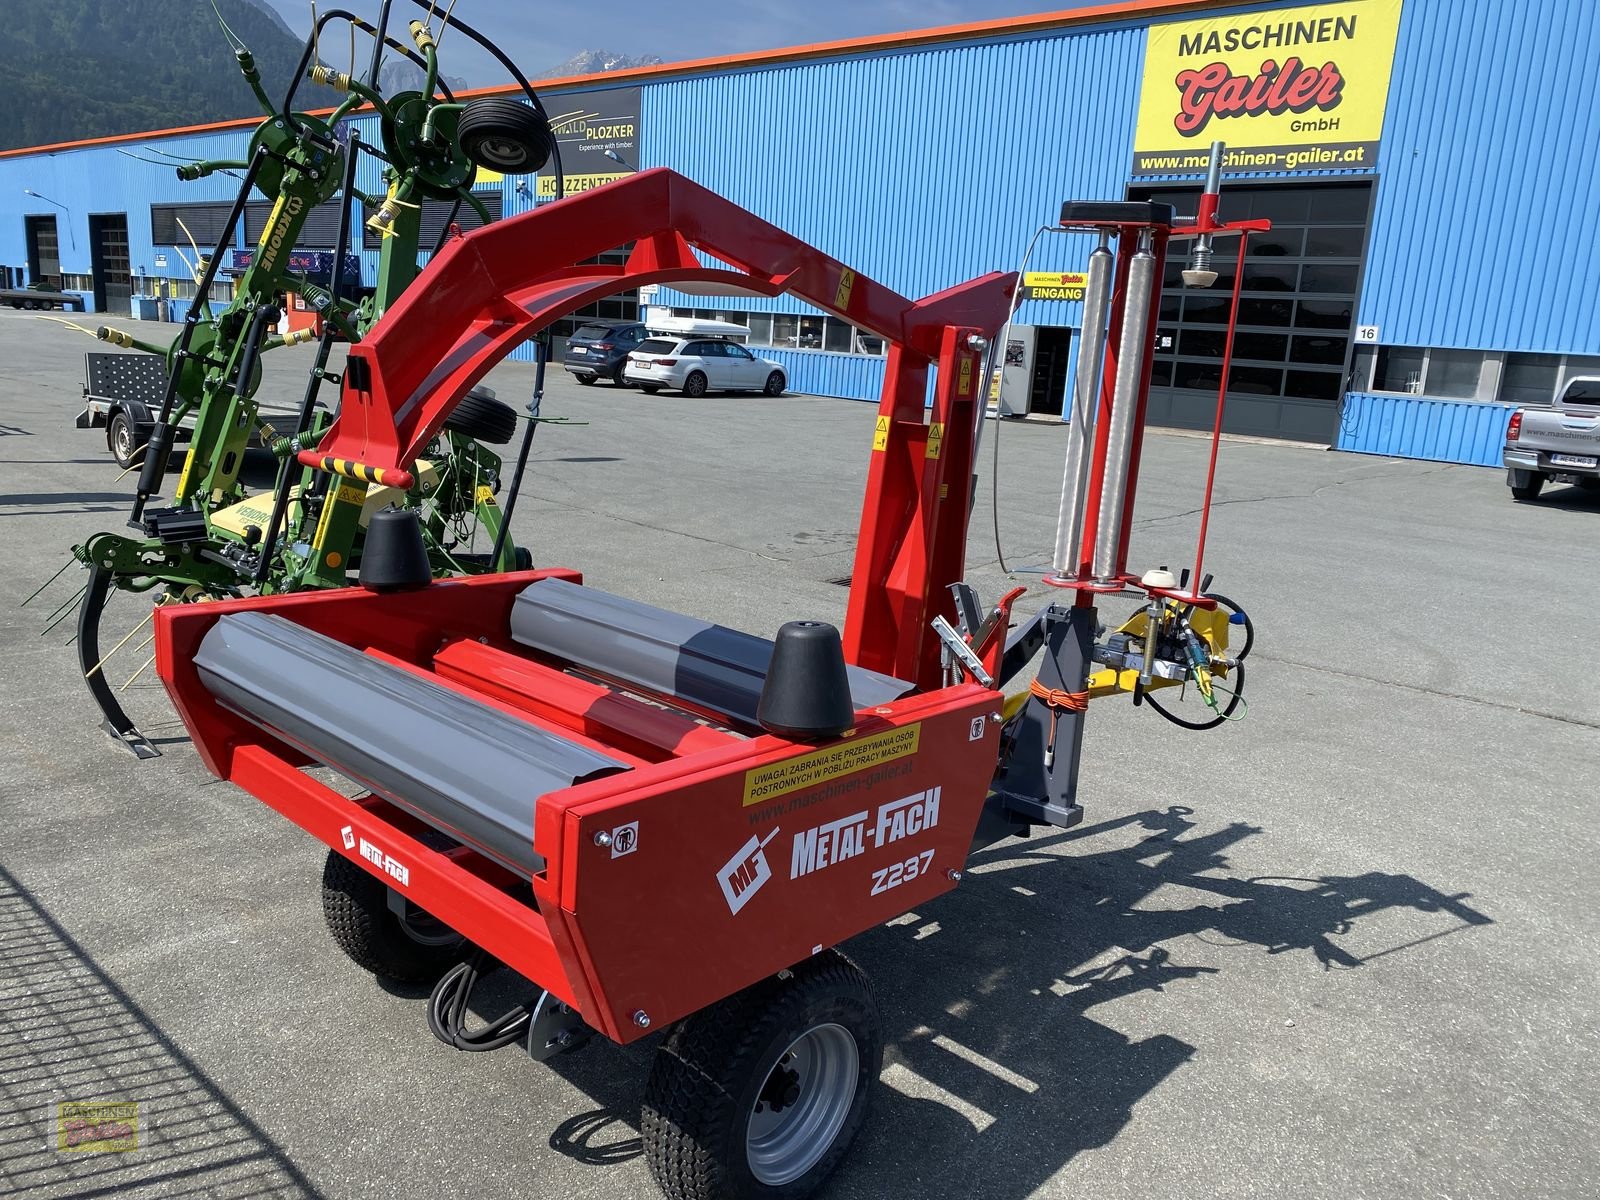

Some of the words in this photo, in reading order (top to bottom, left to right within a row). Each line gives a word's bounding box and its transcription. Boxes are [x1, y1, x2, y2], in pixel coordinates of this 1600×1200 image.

[1178, 15, 1357, 56] MASCHINEN
[1174, 57, 1346, 137] Gailer
[579, 144, 604, 152] Experience
[1290, 118, 1340, 132] GmbH
[1140, 147, 1364, 169] www.machinen-gailer.at
[261, 211, 293, 272] KRONE
[1032, 287, 1082, 299] EINGANG
[1361, 328, 1375, 338] 16
[750, 774, 812, 798] POSTRONNYCH
[814, 770, 821, 779] W
[823, 760, 855, 778] POBLIŻU
[856, 752, 880, 768] PRACY
[881, 742, 913, 758] MASZYNY
[754, 769, 788, 785] UWAGA!
[789, 757, 829, 775] ZABRANIA
[830, 751, 842, 764] SIĘ
[844, 737, 894, 757] PRZEBYWANIA
[895, 730, 914, 743] OSÓB
[749, 761, 913, 825] www.maschinen-gailer.at
[728, 851, 762, 898] MF
[870, 848, 935, 897] Z237
